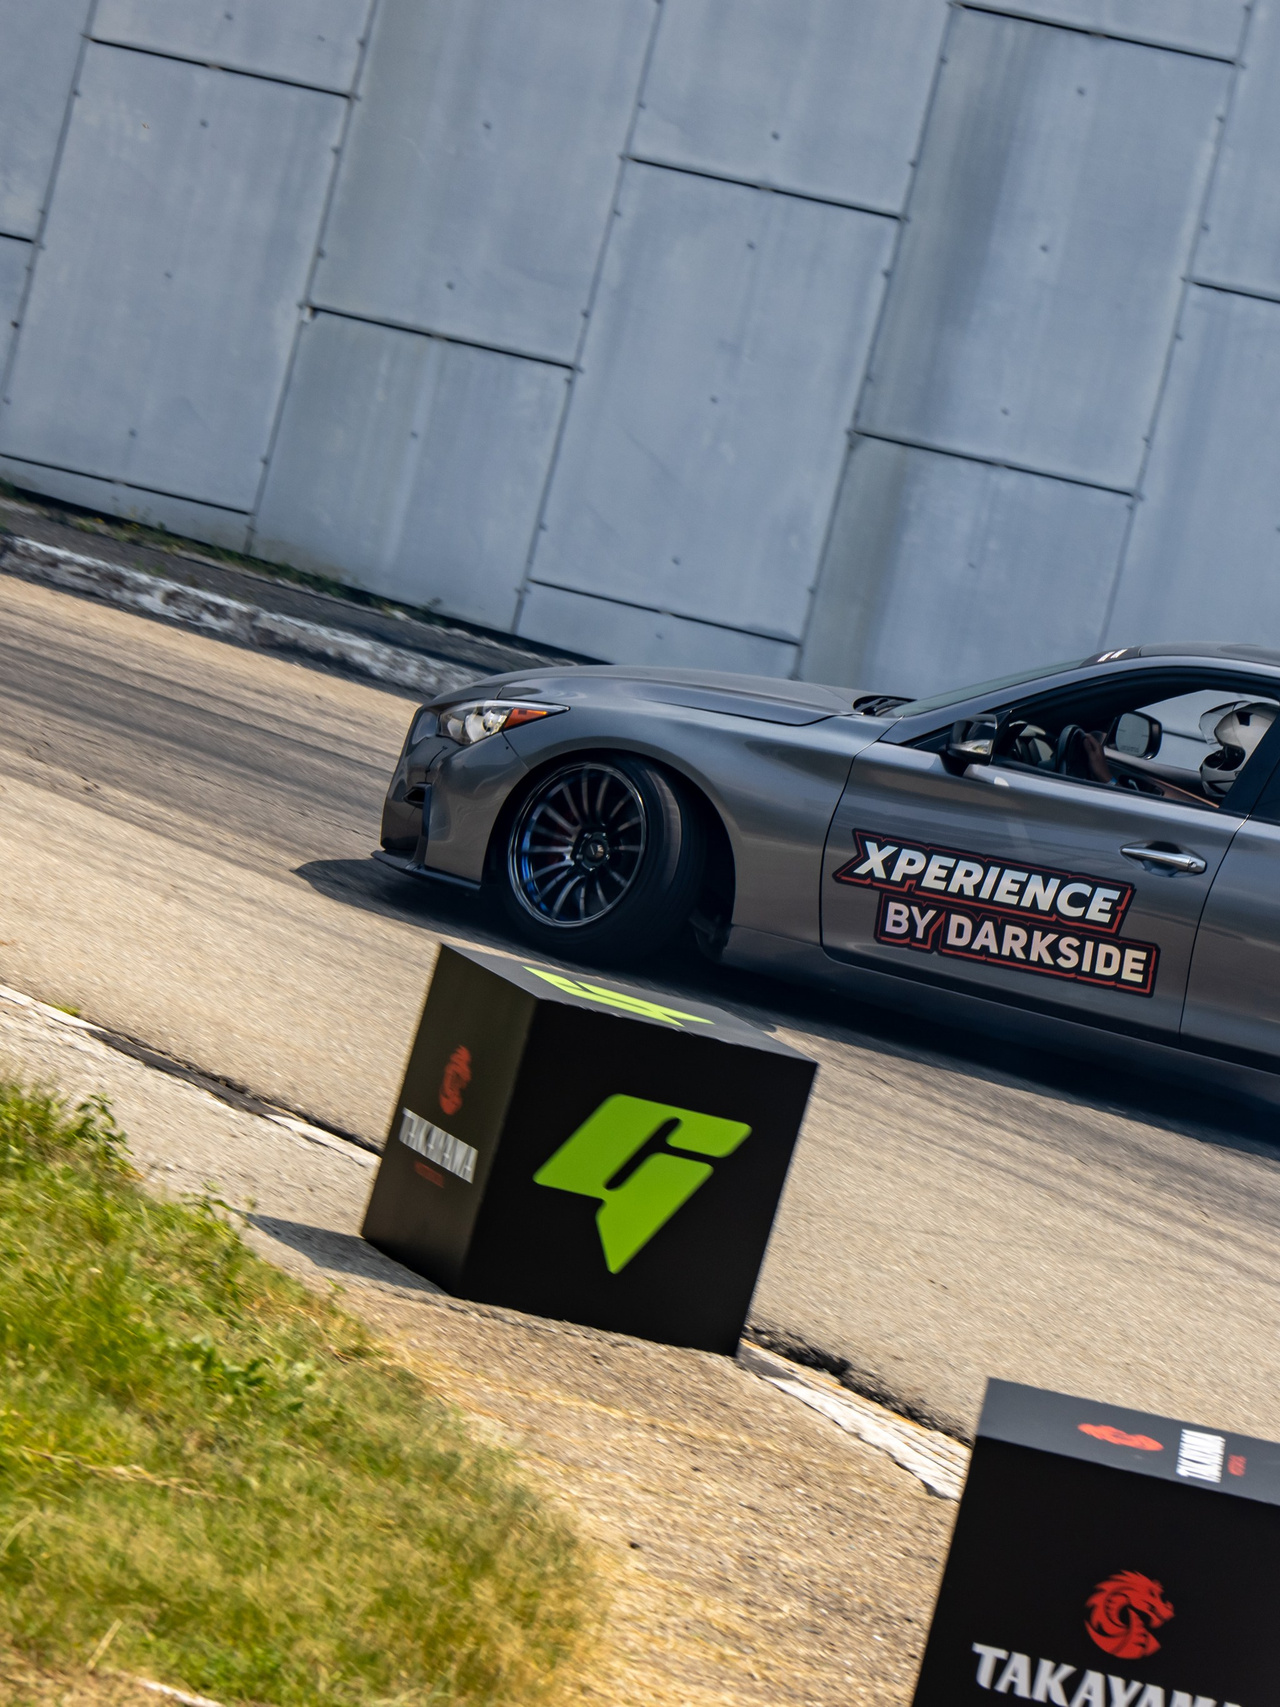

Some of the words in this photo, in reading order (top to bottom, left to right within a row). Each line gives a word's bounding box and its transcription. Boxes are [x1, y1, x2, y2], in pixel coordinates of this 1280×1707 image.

[853, 841, 1121, 923] XPERIENCE
[885, 901, 937, 939] BY
[946, 914, 1147, 983] DARKSIDE
[971, 1641, 1242, 1707] TAKAYA
